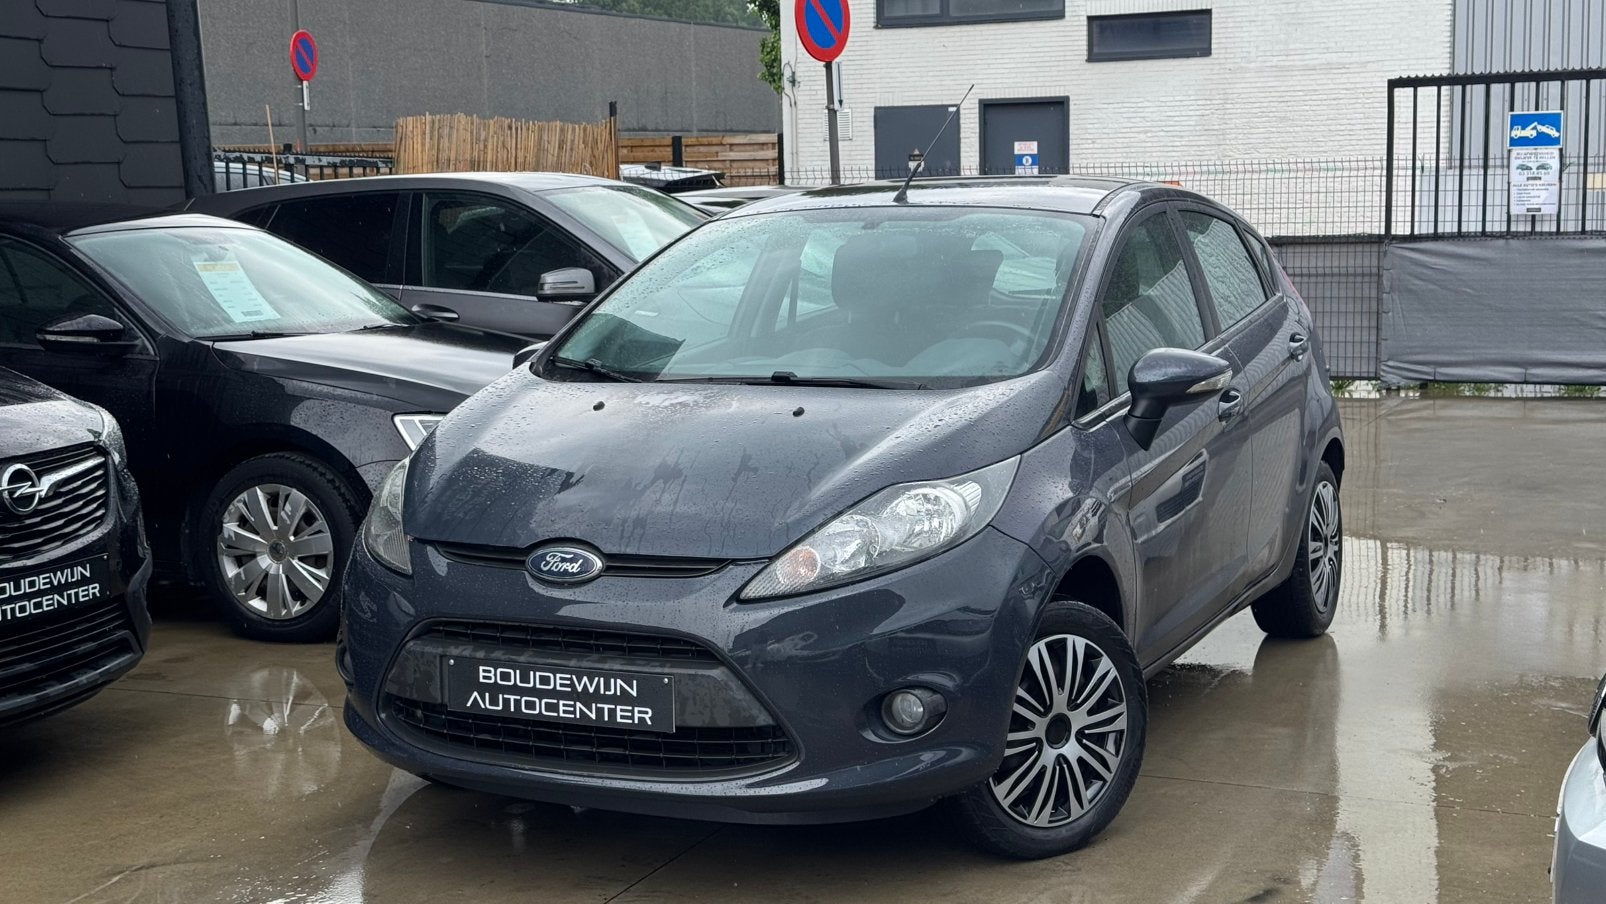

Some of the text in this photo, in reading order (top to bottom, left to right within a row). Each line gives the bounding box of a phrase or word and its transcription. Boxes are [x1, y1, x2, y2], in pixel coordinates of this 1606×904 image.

[540, 552, 583, 573] Ford
[0, 563, 91, 599] OUDEWIJN
[0, 583, 101, 622] TOCENTER
[479, 665, 637, 697] BOUDEWIJN
[466, 691, 652, 725] AUTOCENTER
